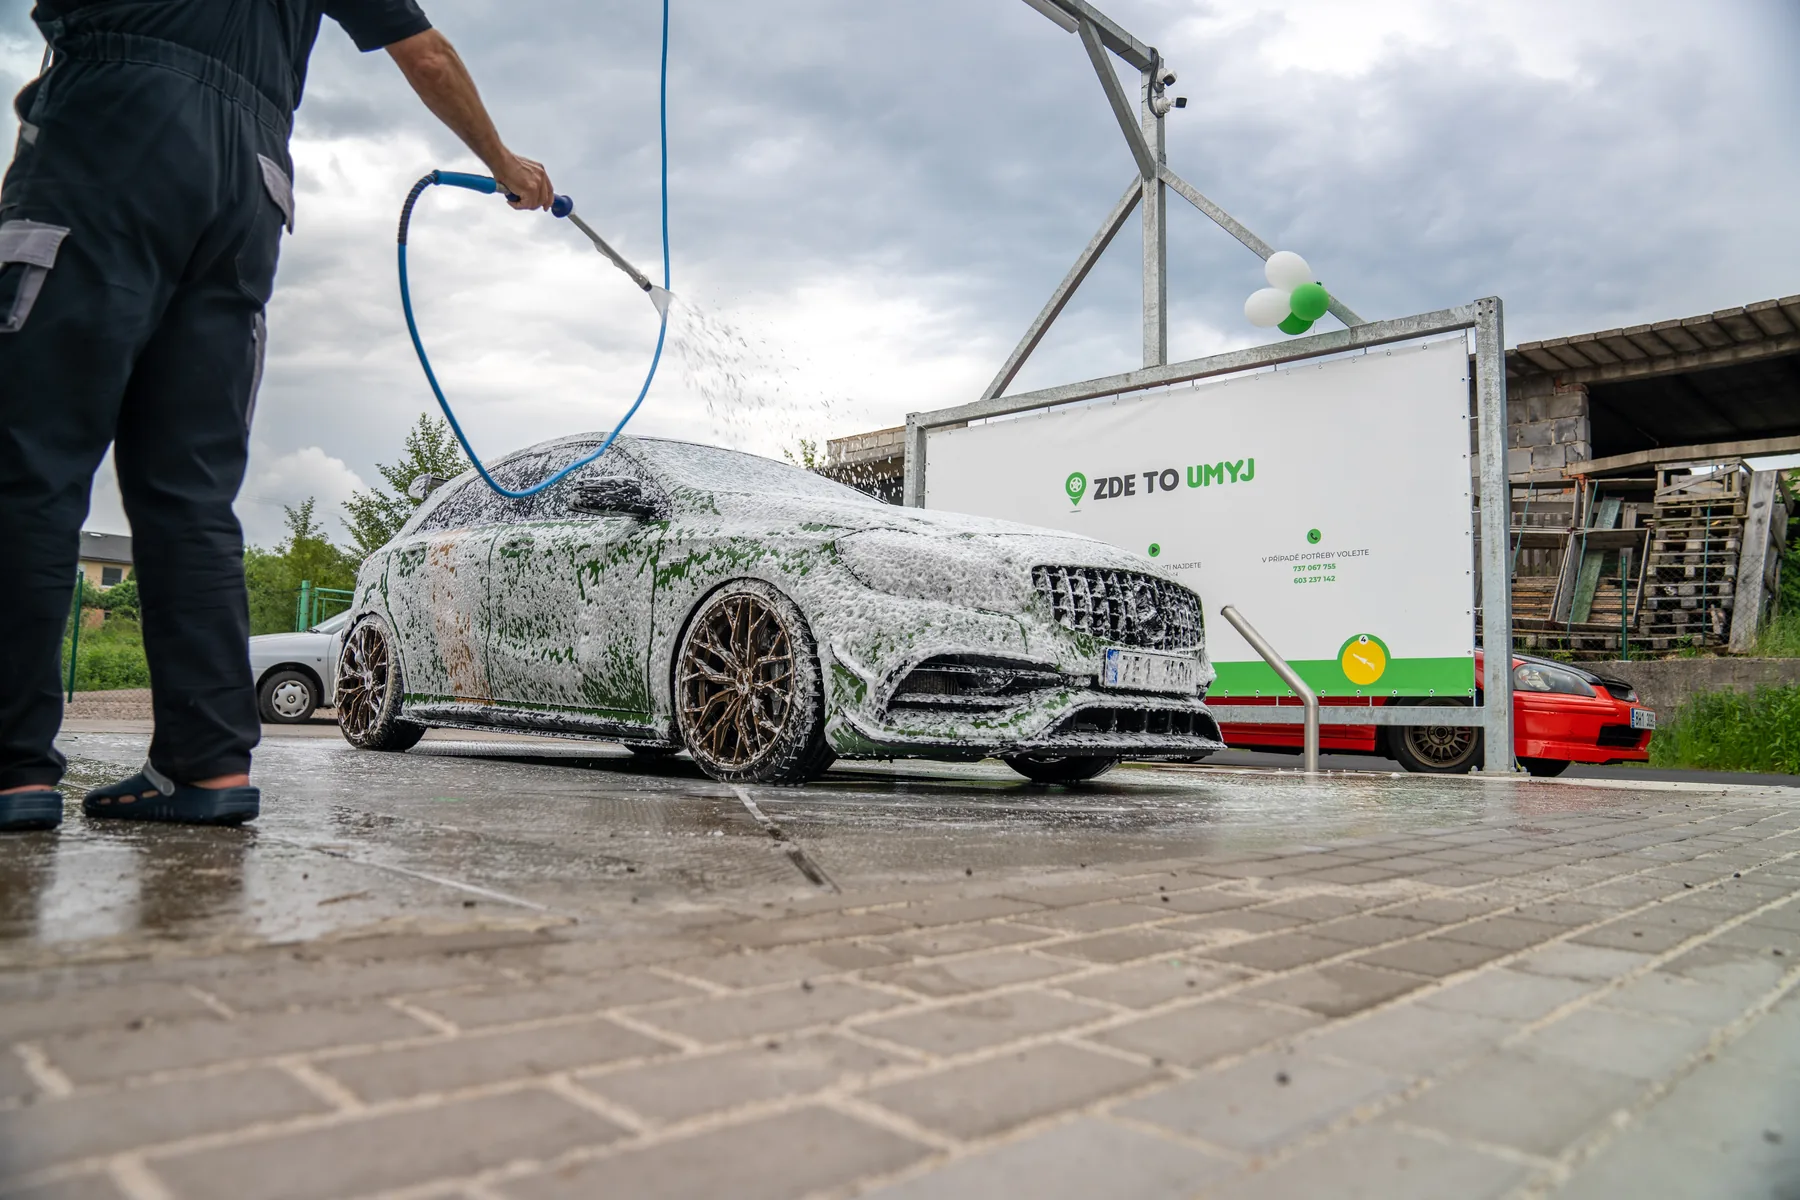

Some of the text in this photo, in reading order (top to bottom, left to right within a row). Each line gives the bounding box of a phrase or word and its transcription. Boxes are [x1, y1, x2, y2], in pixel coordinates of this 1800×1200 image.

[1093, 457, 1255, 501] ZDE TO UMYJ
[1268, 553, 1299, 563] PŘÍPADĚ
[1301, 551, 1336, 561] POTŘEBY
[1336, 549, 1370, 558] VOLEJTE
[1172, 561, 1202, 570] NAJDETE
